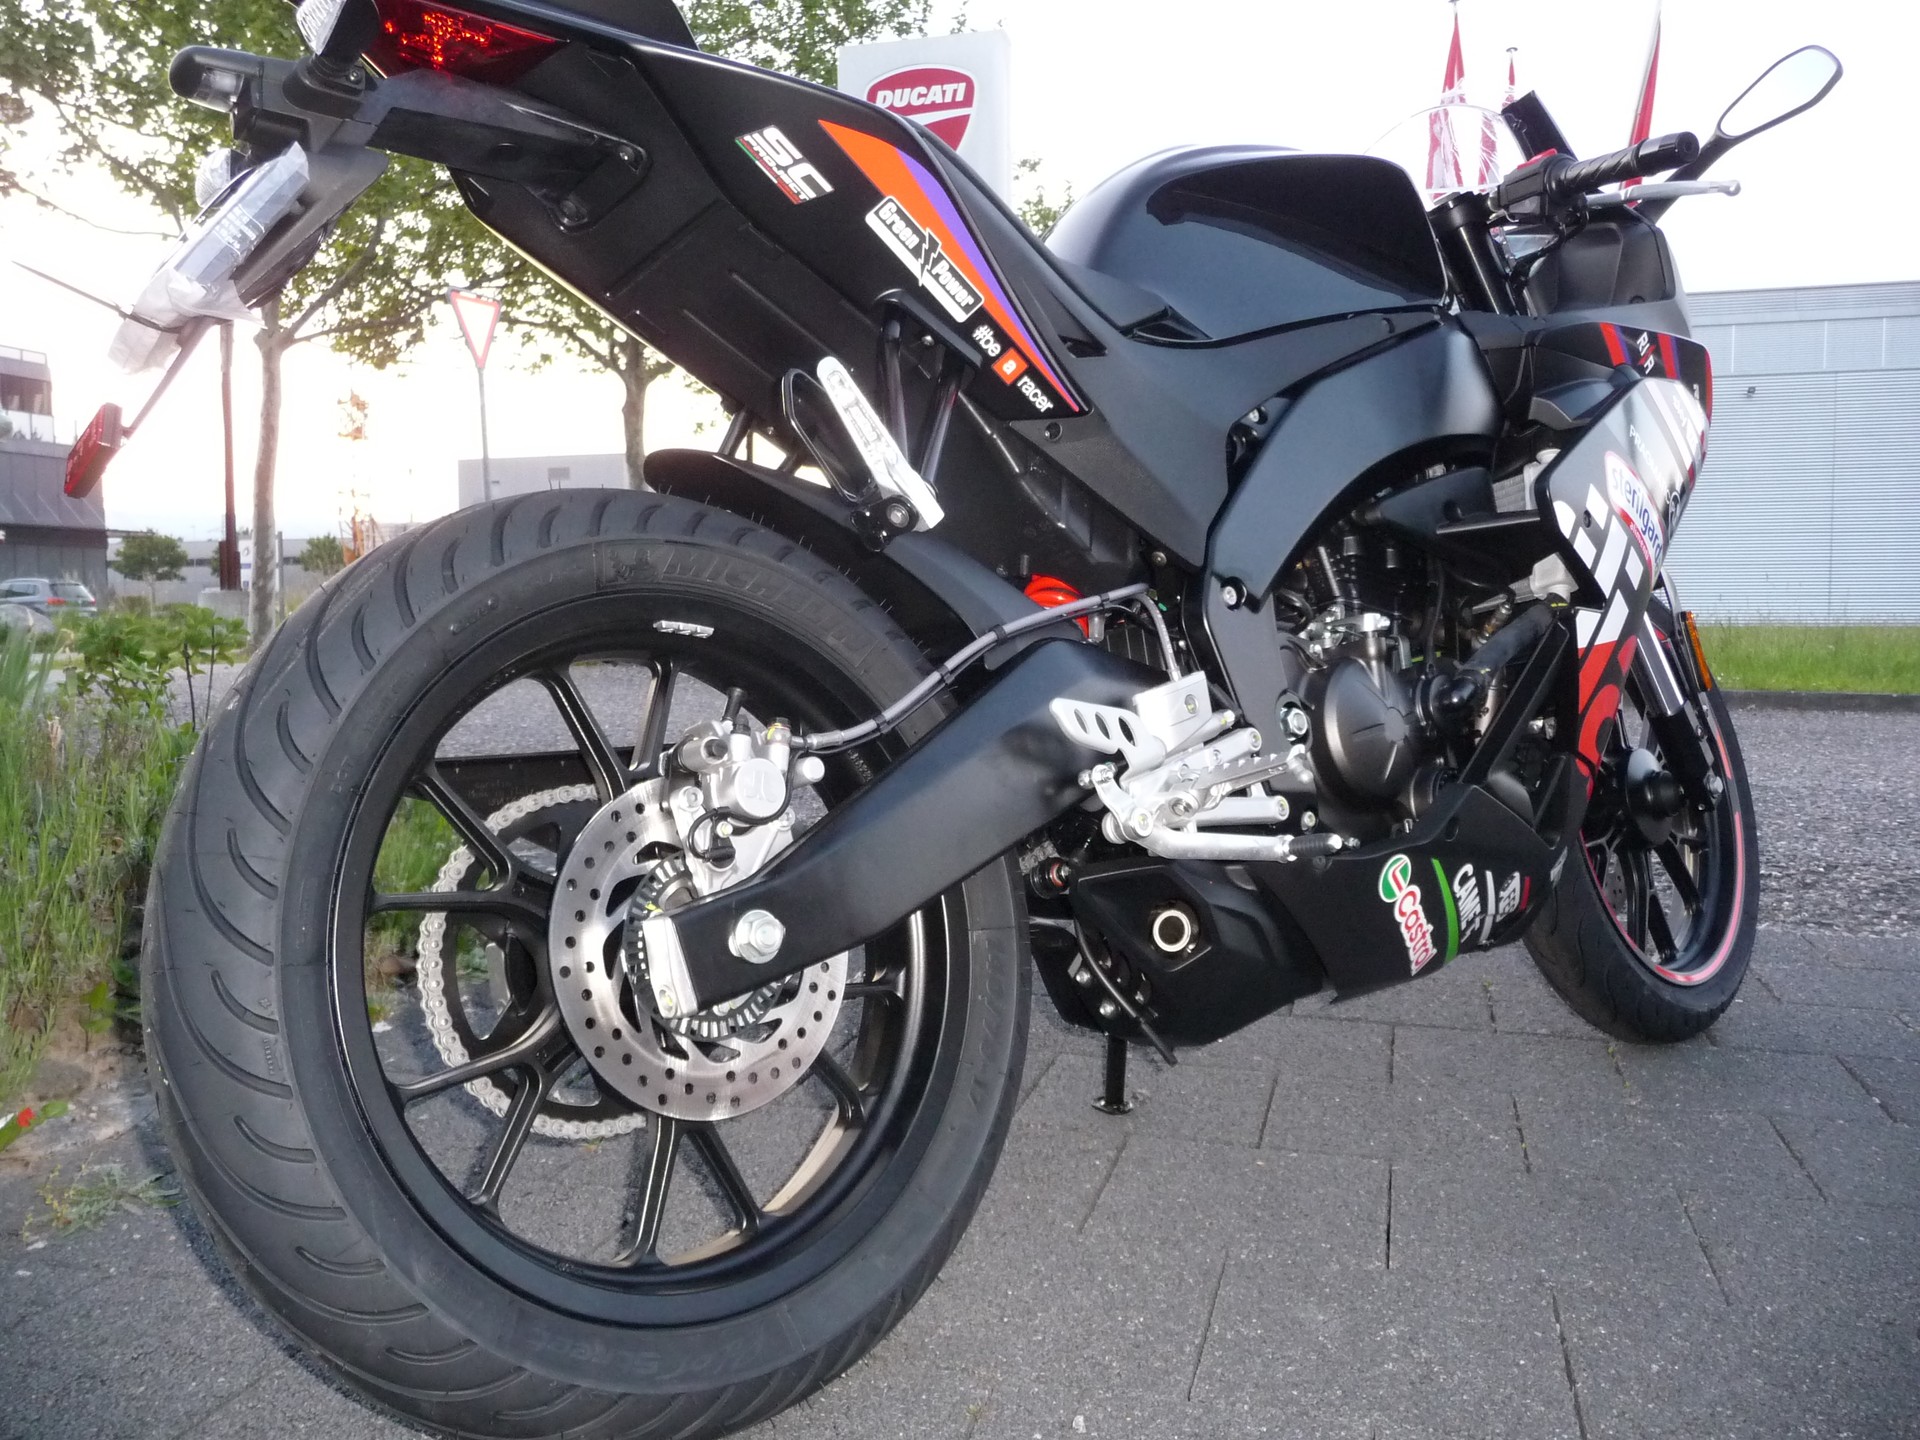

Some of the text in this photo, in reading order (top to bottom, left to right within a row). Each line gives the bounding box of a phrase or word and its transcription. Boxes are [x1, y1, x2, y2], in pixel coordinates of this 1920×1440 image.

[875, 82, 967, 108] DUCATI
[752, 127, 835, 199] SC
[878, 200, 975, 308] Green Power
[972, 324, 1001, 357] #be
[1017, 376, 1054, 414] racer
[1611, 466, 1663, 568] sterilgard
[1396, 887, 1436, 974] Castrol
